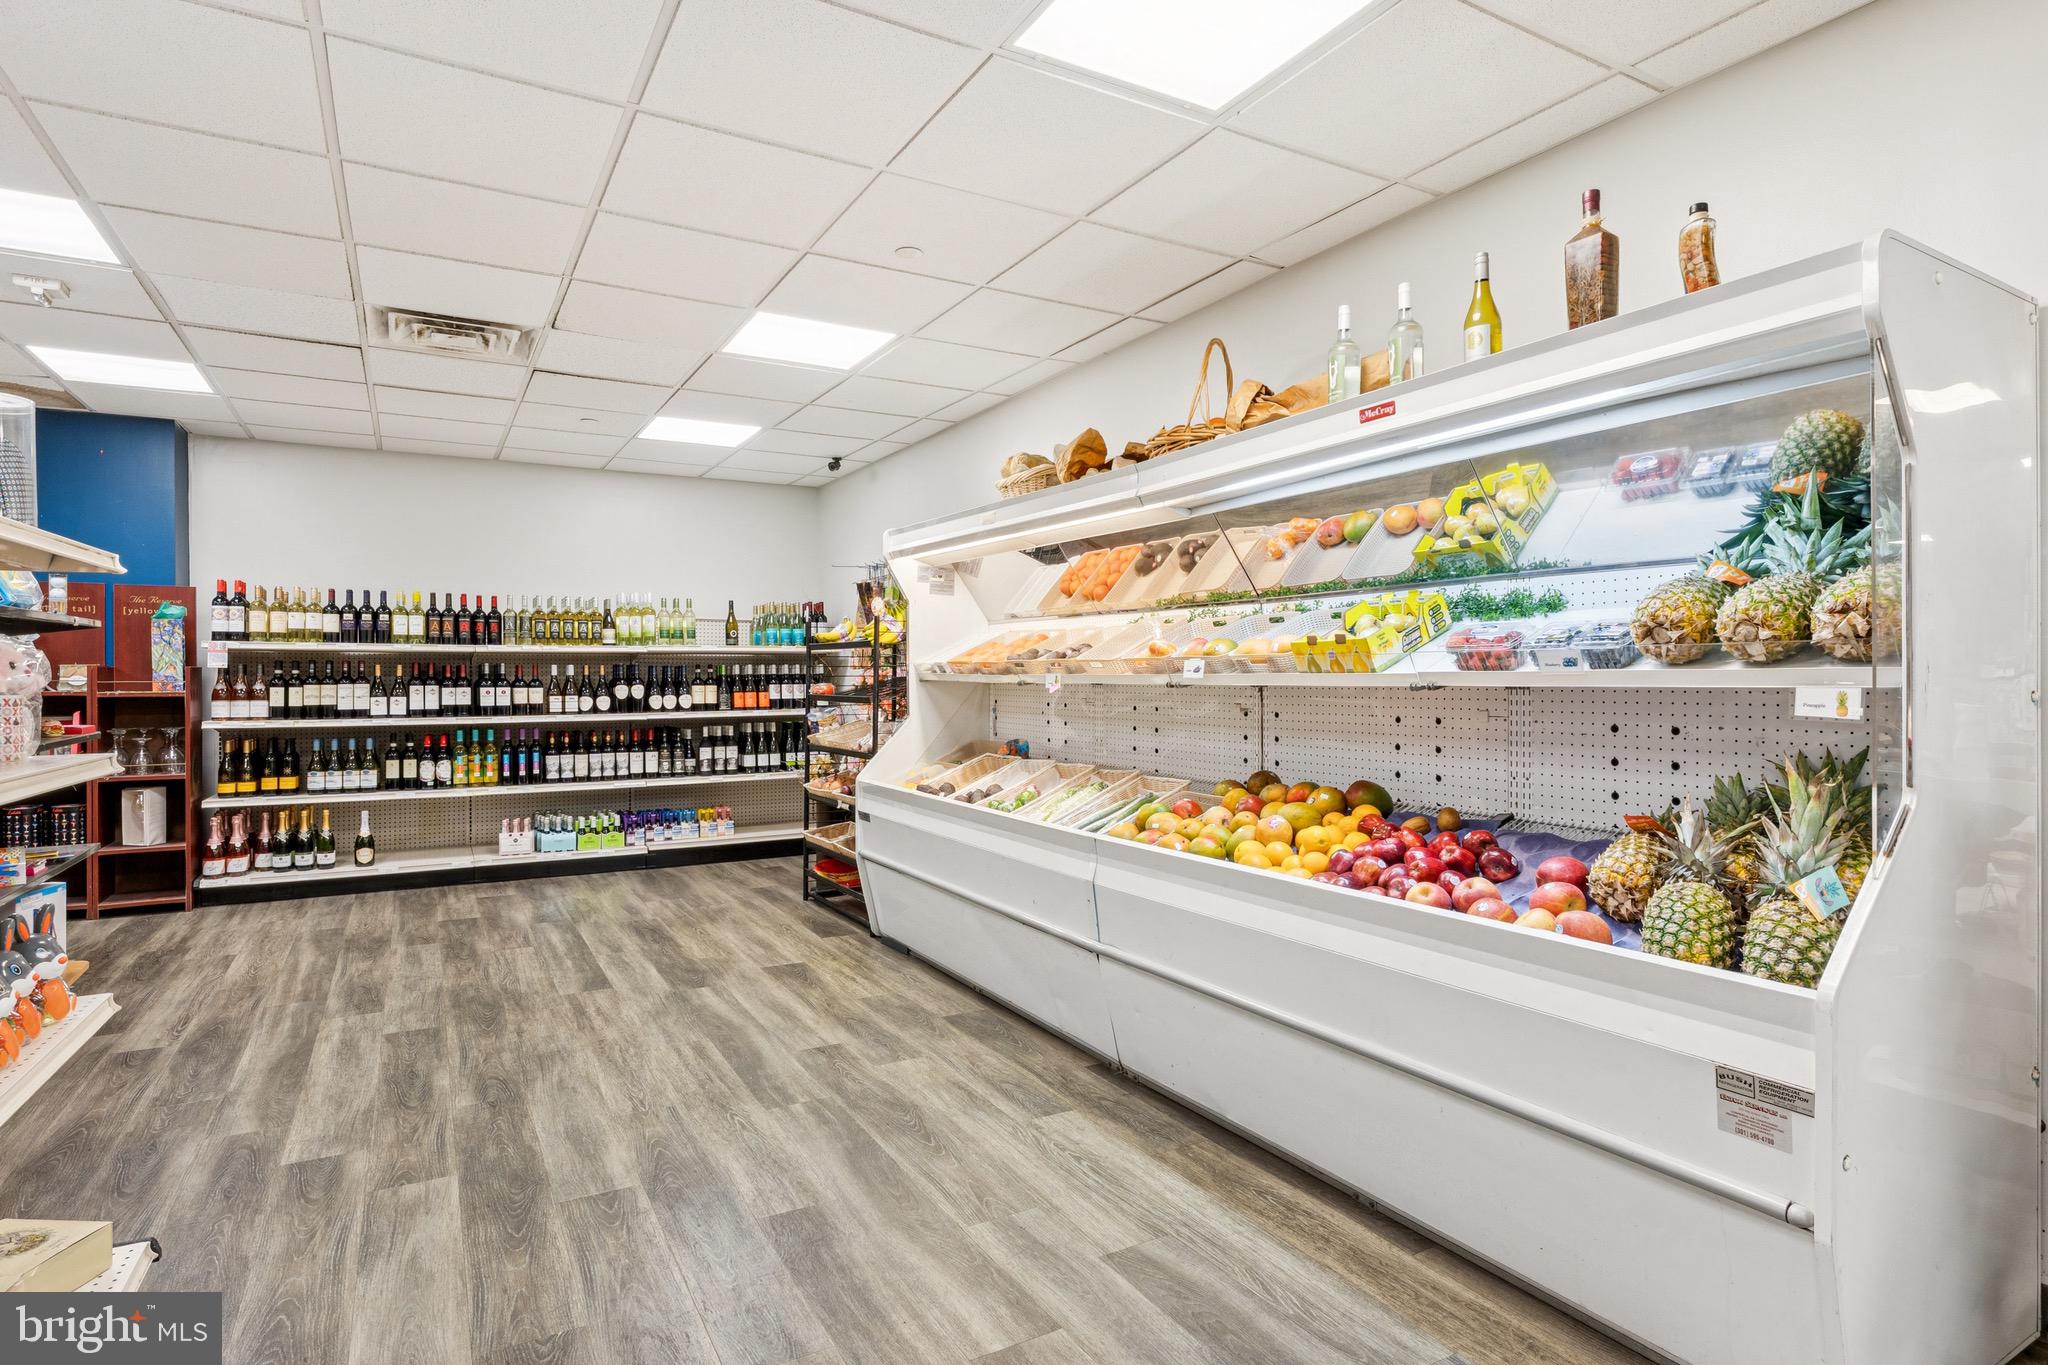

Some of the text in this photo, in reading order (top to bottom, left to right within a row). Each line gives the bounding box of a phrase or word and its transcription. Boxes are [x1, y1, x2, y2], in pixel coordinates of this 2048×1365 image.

[1719, 1073, 1752, 1088] BUSH
[1759, 1080, 1801, 1096] COMMERCIAL
[1759, 1084, 1809, 1103] REFRIGERATION
[1759, 1089, 1797, 1104] EQUIPMENT
